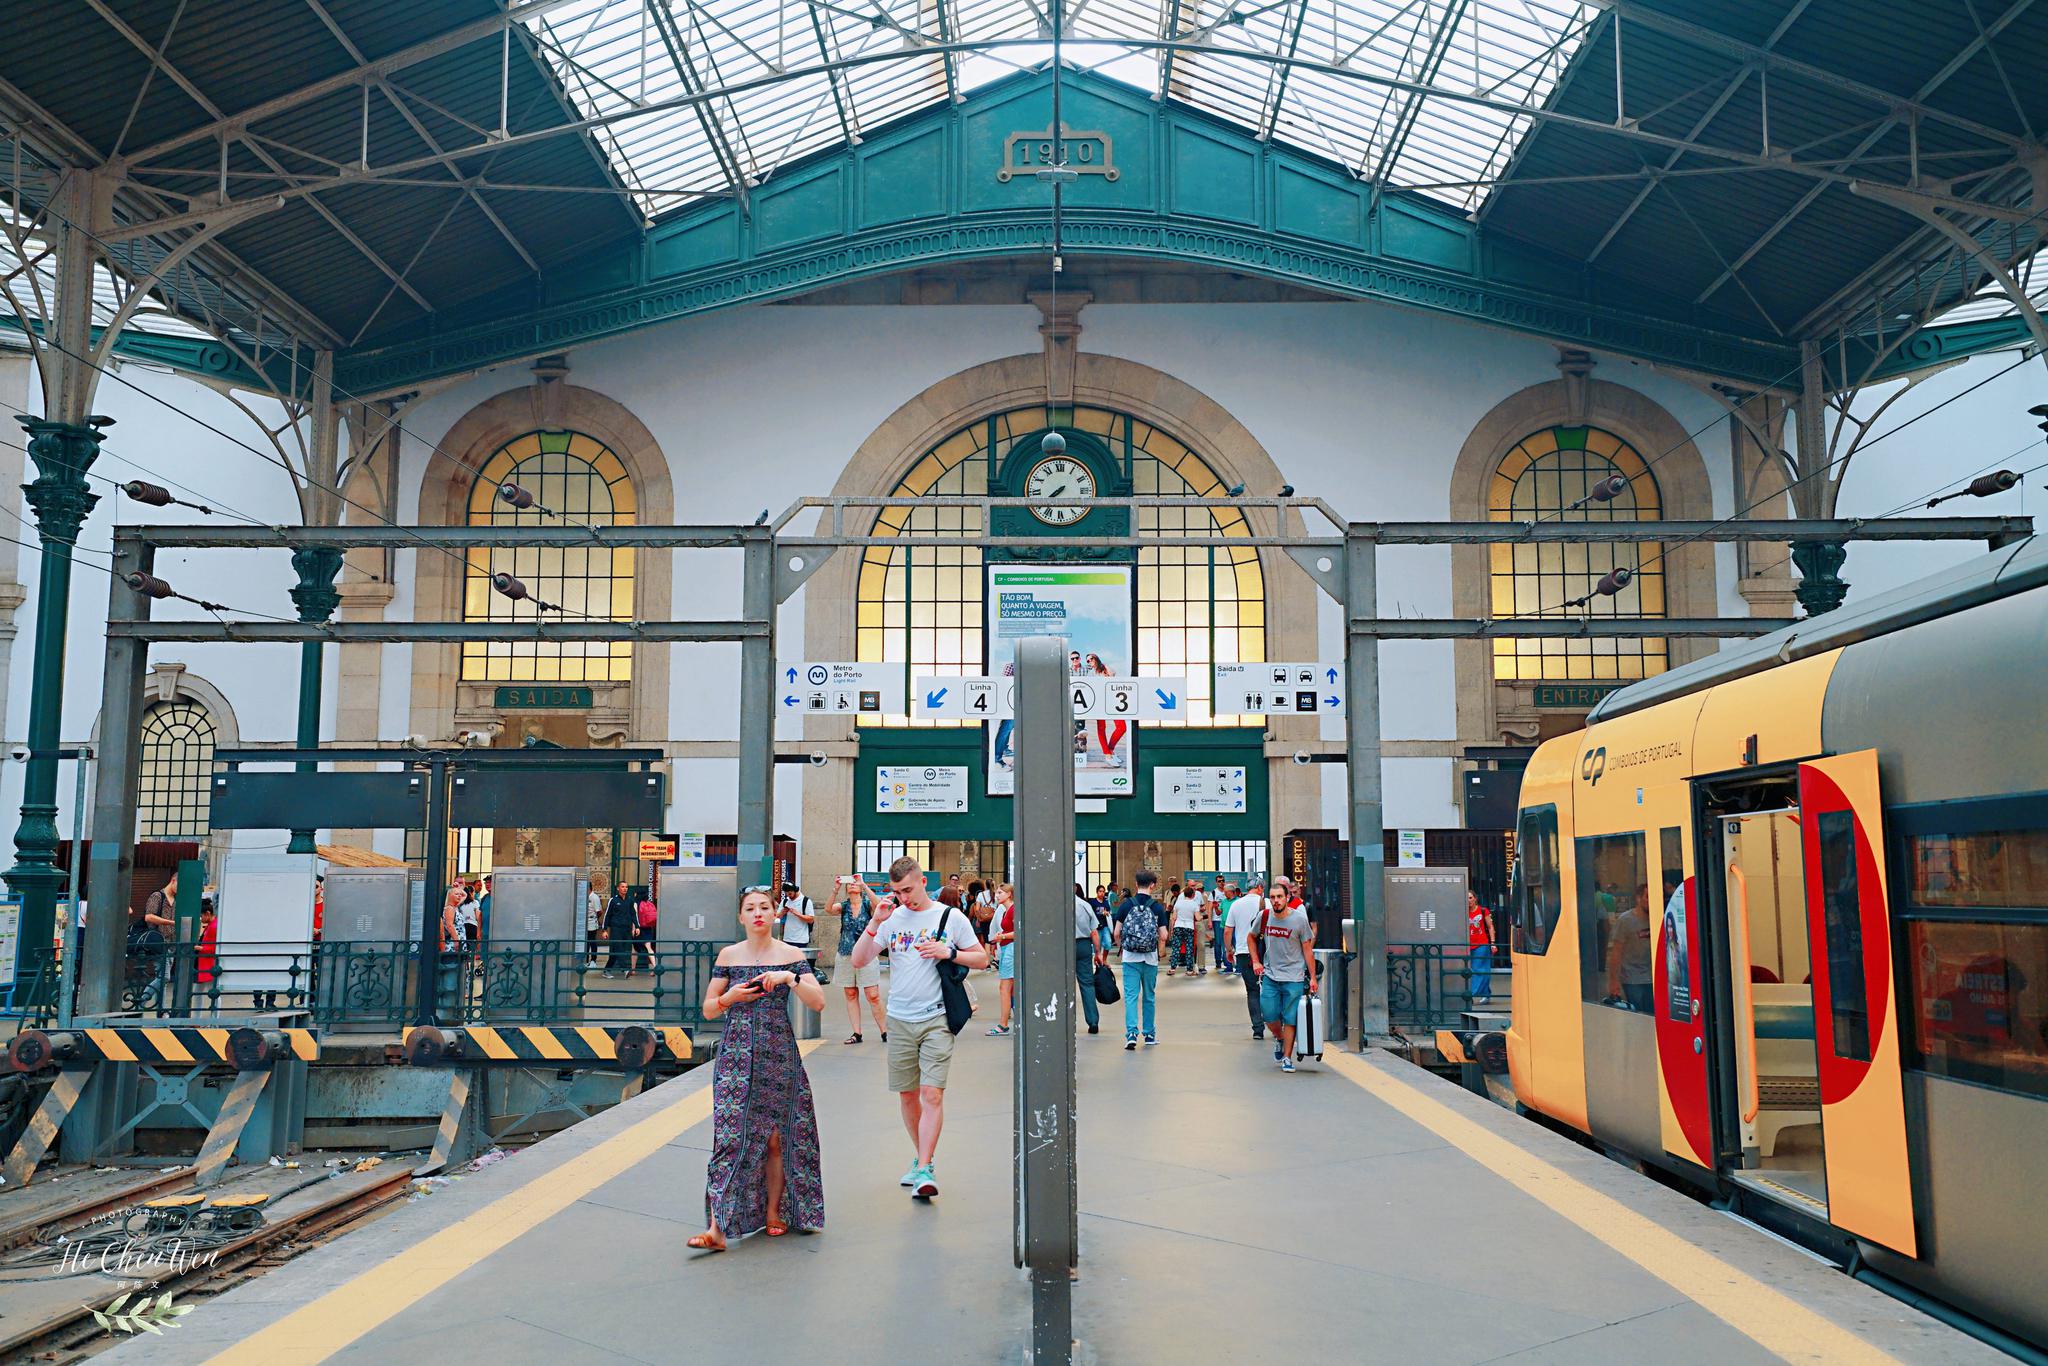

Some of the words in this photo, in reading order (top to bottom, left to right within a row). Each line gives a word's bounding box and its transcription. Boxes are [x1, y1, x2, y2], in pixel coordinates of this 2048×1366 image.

[1021, 143, 1093, 163] 1910
[1042, 610, 1064, 618] PREÇO.
[973, 693, 987, 712] 4
[1073, 689, 1088, 709] A
[1115, 692, 1129, 712] 3
[1648, 741, 1682, 762] PORTUGAL
[1173, 785, 1181, 794] P
[956, 800, 964, 808] P
[1293, 840, 1303, 873] PORTO
[1505, 840, 1514, 873] PORTO
